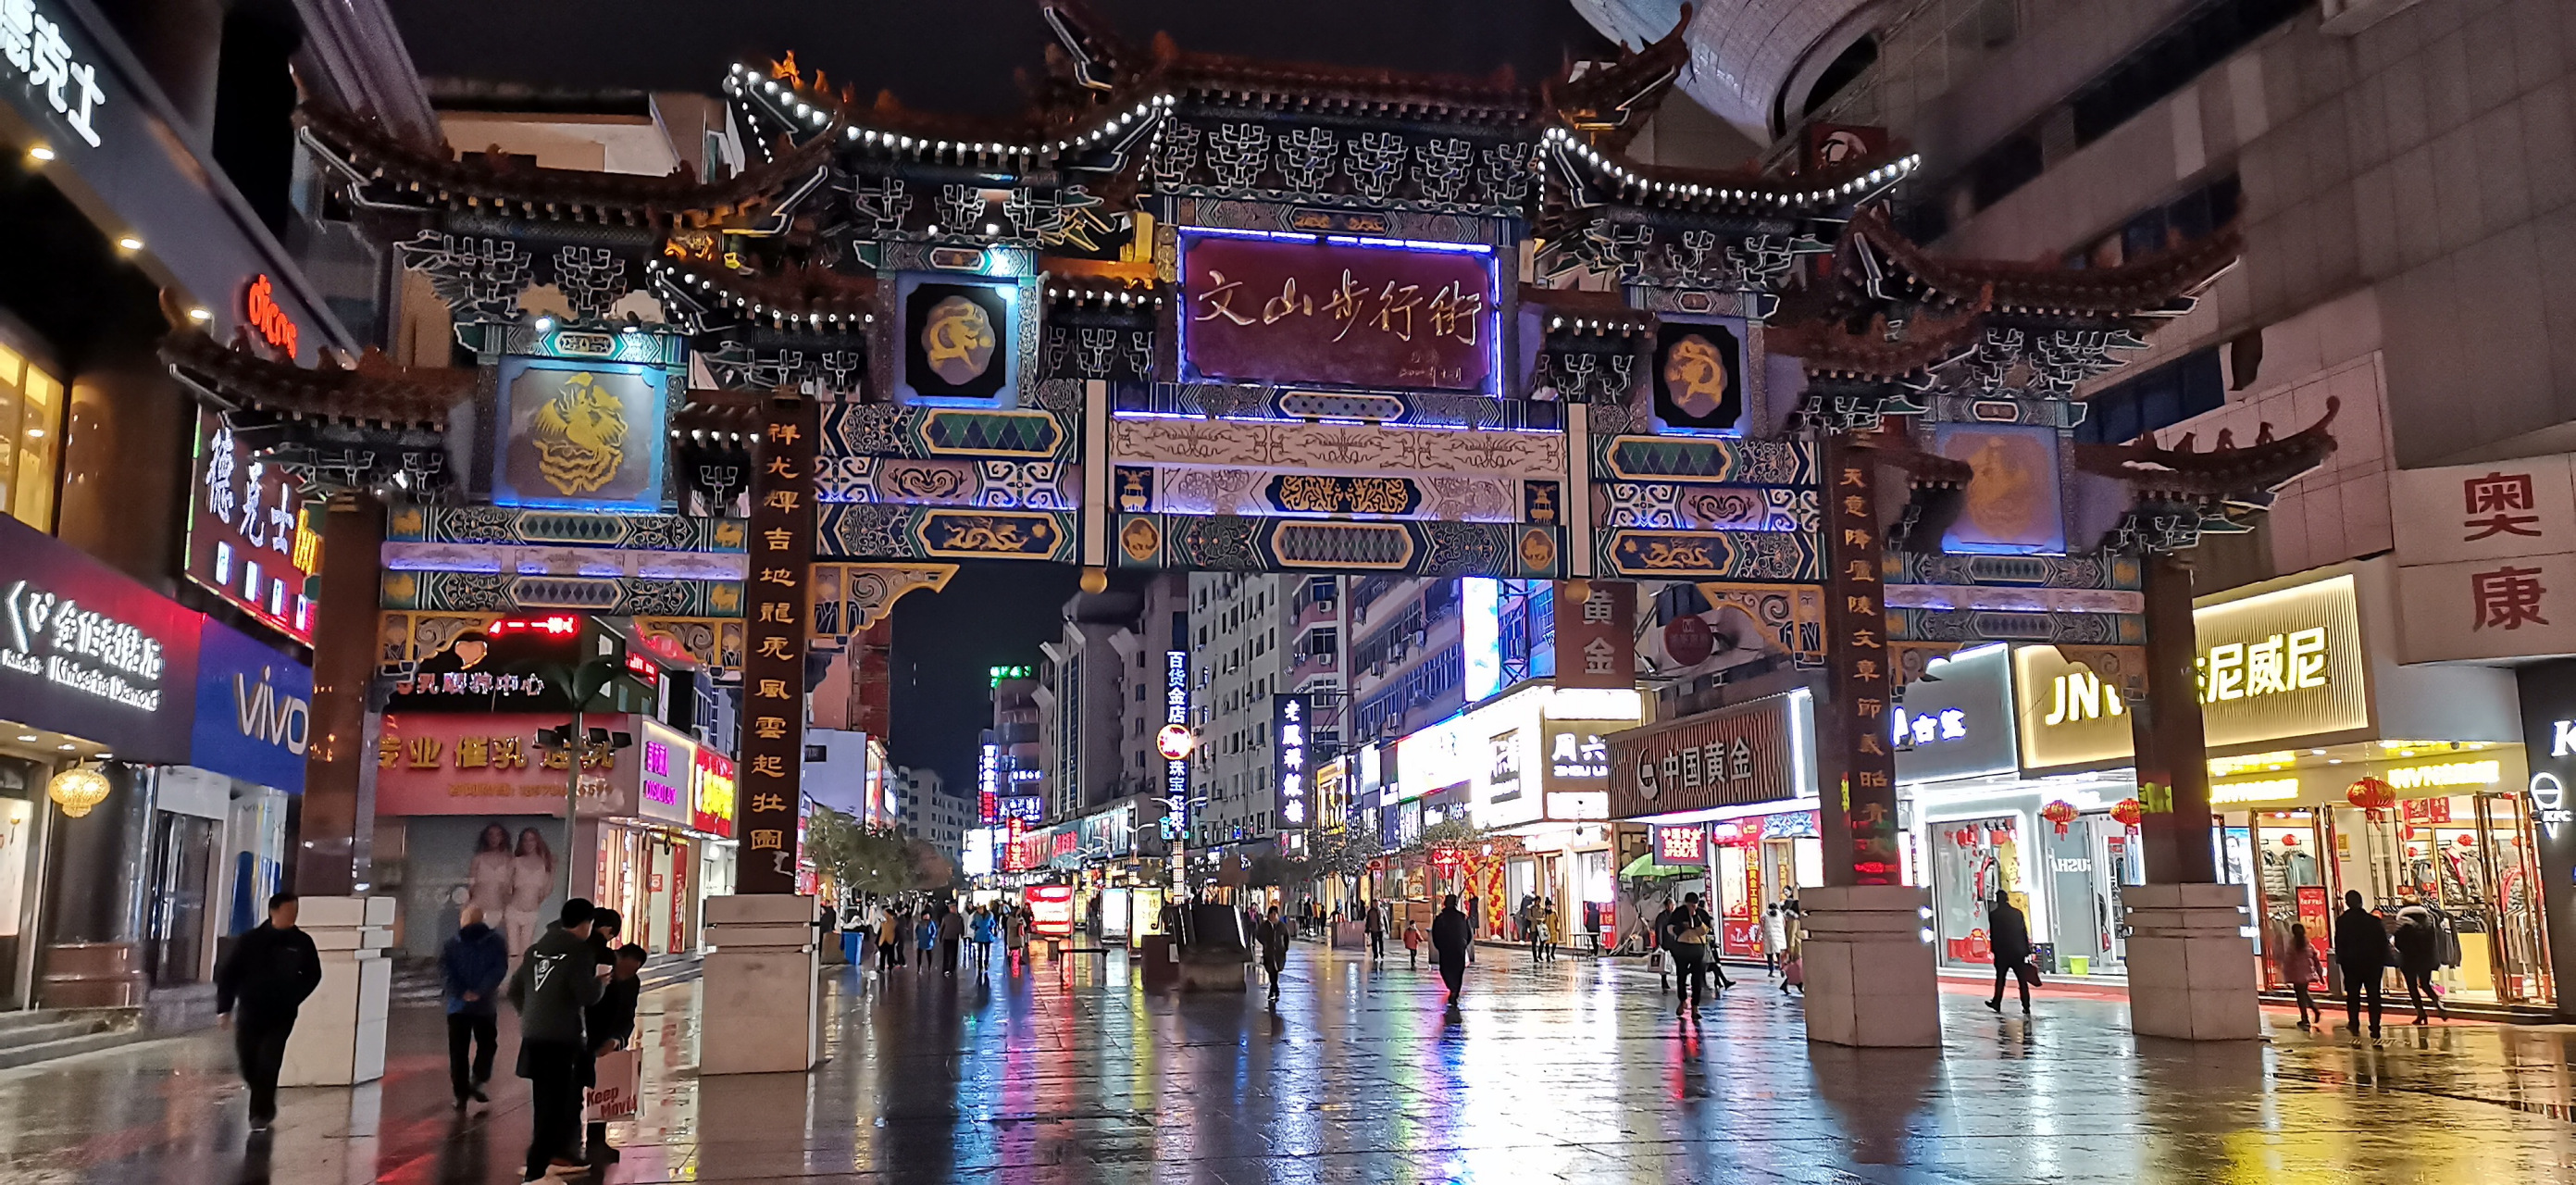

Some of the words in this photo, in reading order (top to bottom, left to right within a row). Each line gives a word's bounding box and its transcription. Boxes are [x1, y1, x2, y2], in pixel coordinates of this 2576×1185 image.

[248, 273, 298, 359] dicos
[1194, 268, 1482, 346] 文山步行街
[205, 426, 295, 555] 德克士
[2464, 471, 2550, 633] 奥康
[1583, 589, 1616, 675] 黄金
[236, 664, 310, 755] vivo
[1167, 651, 1187, 724] 百货金店
[378, 733, 442, 769] 专业
[454, 735, 529, 769] 催乳
[1662, 736, 1751, 790] 中国黄金
[2543, 810, 2572, 822] KFC
[586, 1086, 619, 1108] Keep
